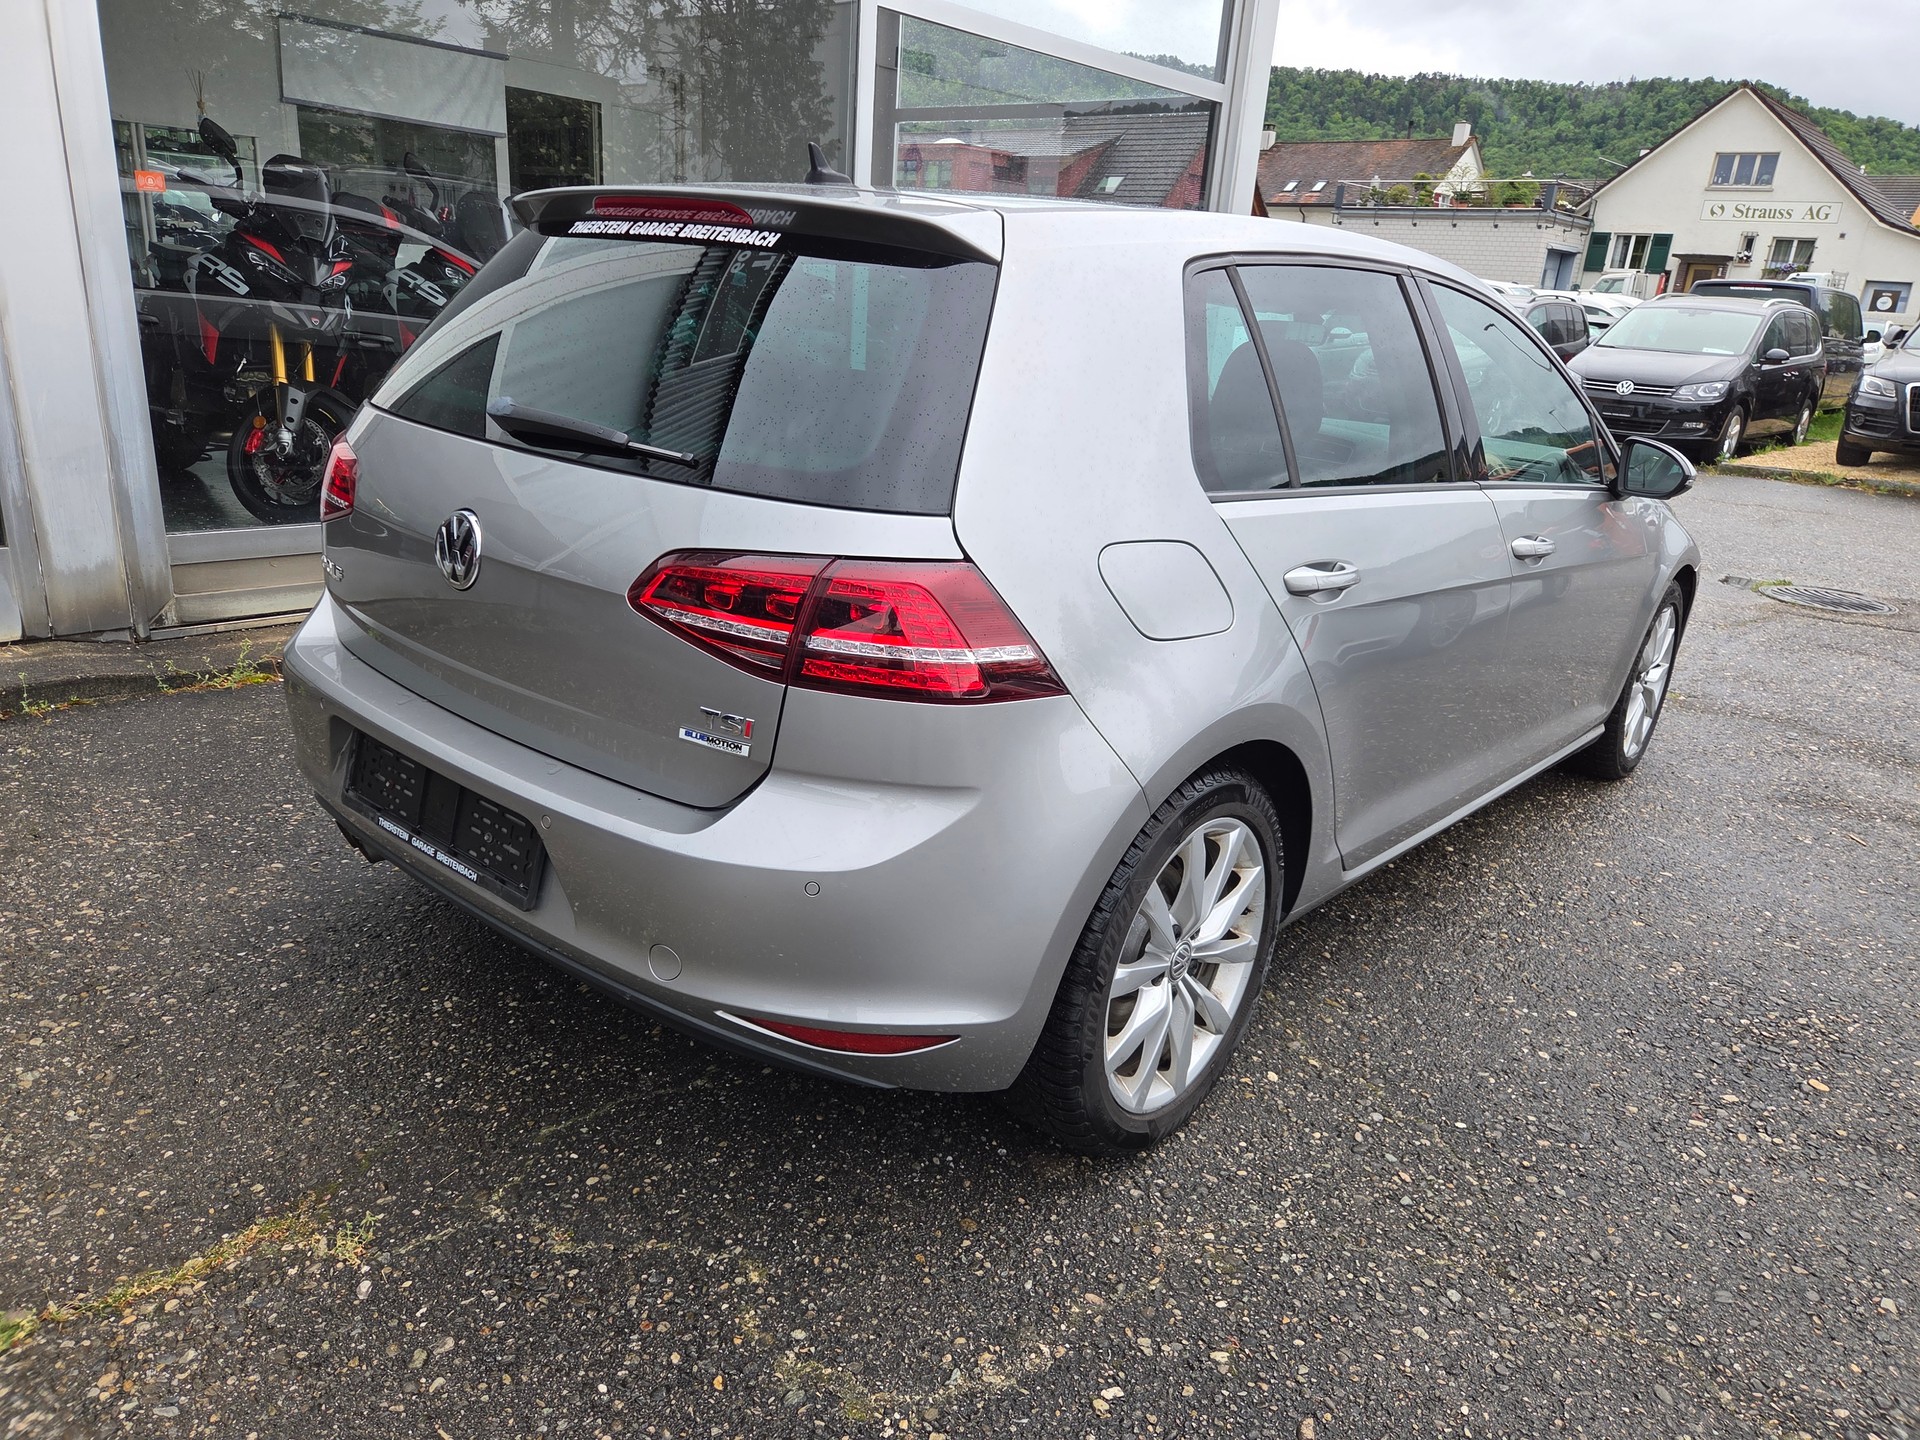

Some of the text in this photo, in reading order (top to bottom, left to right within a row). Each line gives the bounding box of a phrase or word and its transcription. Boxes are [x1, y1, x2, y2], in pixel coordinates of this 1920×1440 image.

[1732, 203, 1794, 219] Strauss
[1801, 205, 1832, 220] AG
[567, 220, 782, 247] THIERSTEIN GARAGE BREITENBACH
[700, 706, 755, 739] TSI
[684, 729, 742, 751] BLUEMOTION
[378, 817, 478, 882] THIERSTEIN GARAGE BREITENBACH
